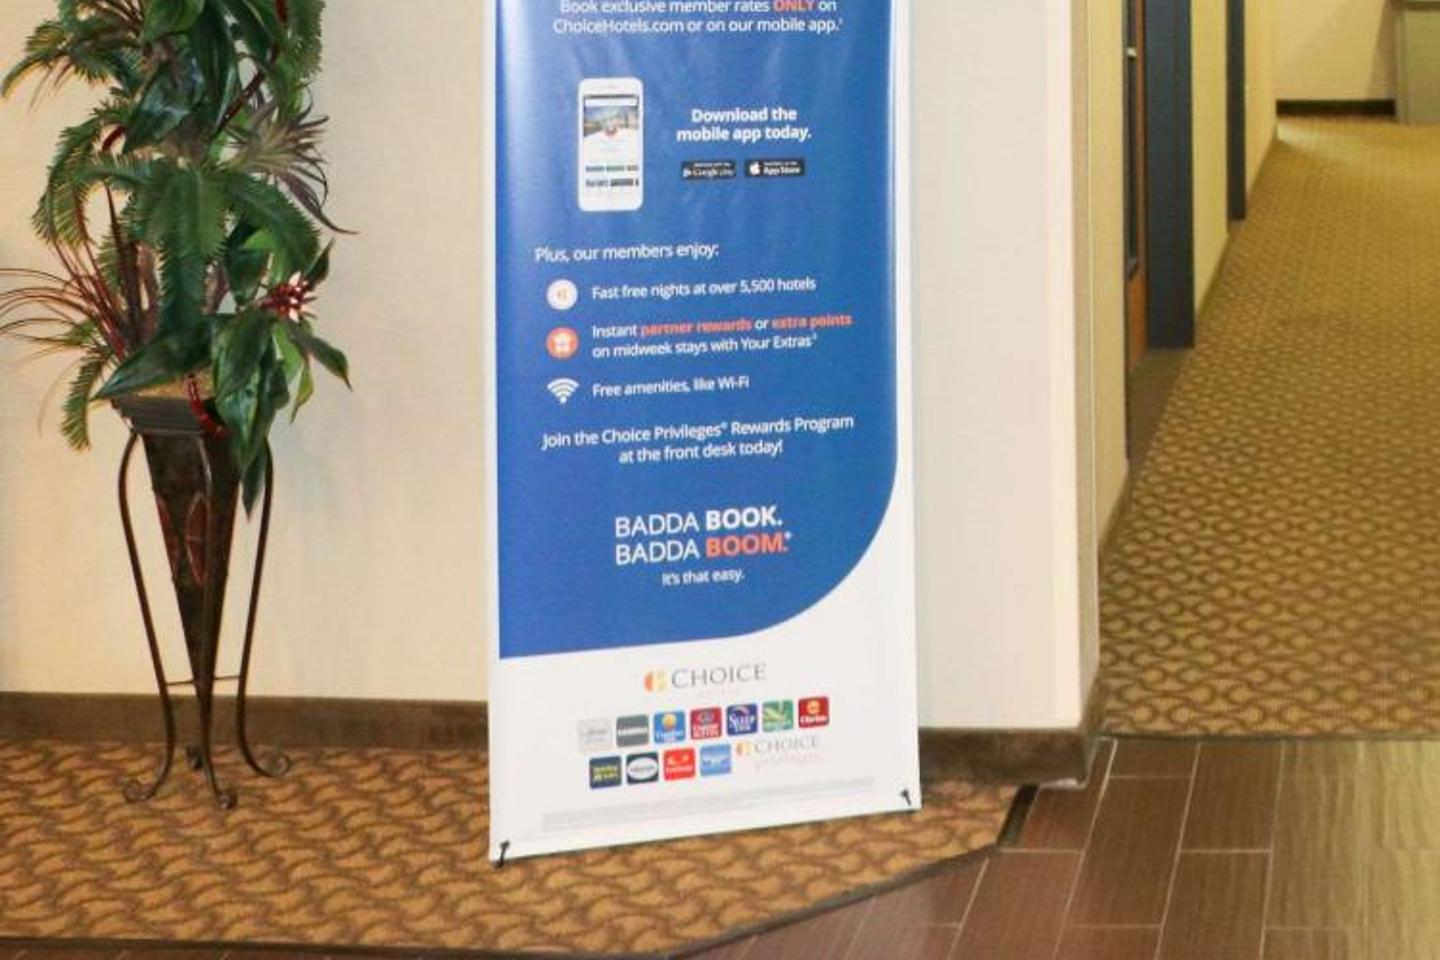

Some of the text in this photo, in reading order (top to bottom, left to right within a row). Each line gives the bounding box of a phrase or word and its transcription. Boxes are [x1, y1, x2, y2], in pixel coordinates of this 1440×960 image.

[733, 0, 771, 13] rates
[818, 0, 837, 12] on
[553, 17, 684, 34] ChoiceHotels.com
[687, 20, 704, 32] or
[706, 20, 726, 32] on
[728, 20, 754, 32] our
[757, 16, 806, 32] mobile
[691, 105, 798, 123] Download the
[676, 125, 812, 144] mobile app today.
[534, 242, 720, 263] Plus, our members enjoy:
[591, 285, 620, 300] Fast
[621, 283, 648, 299] free
[649, 282, 691, 301] nights
[692, 283, 707, 296] at
[708, 282, 738, 295] over
[776, 275, 817, 292] hotels
[591, 324, 638, 339] Instant
[640, 322, 693, 338] partner
[696, 317, 753, 333] rewards
[754, 319, 769, 331] or
[809, 313, 853, 331] points
[591, 346, 611, 358] on
[613, 342, 672, 357] midweek
[674, 341, 708, 356] stays
[709, 337, 739, 353] with
[740, 337, 771, 351] Your
[591, 375, 750, 397] Free amenities, like Wi-Fi
[541, 431, 571, 452] Join
[574, 430, 600, 446] the
[601, 427, 651, 444] Choice
[730, 418, 792, 436] Rewards
[793, 415, 855, 434] Program
[618, 439, 783, 464] at the front desk today!
[614, 504, 783, 539] BADDA BOOK.
[615, 538, 700, 565] BADDA
[661, 568, 746, 587] It's that easy.
[671, 661, 768, 689] CHOICE
